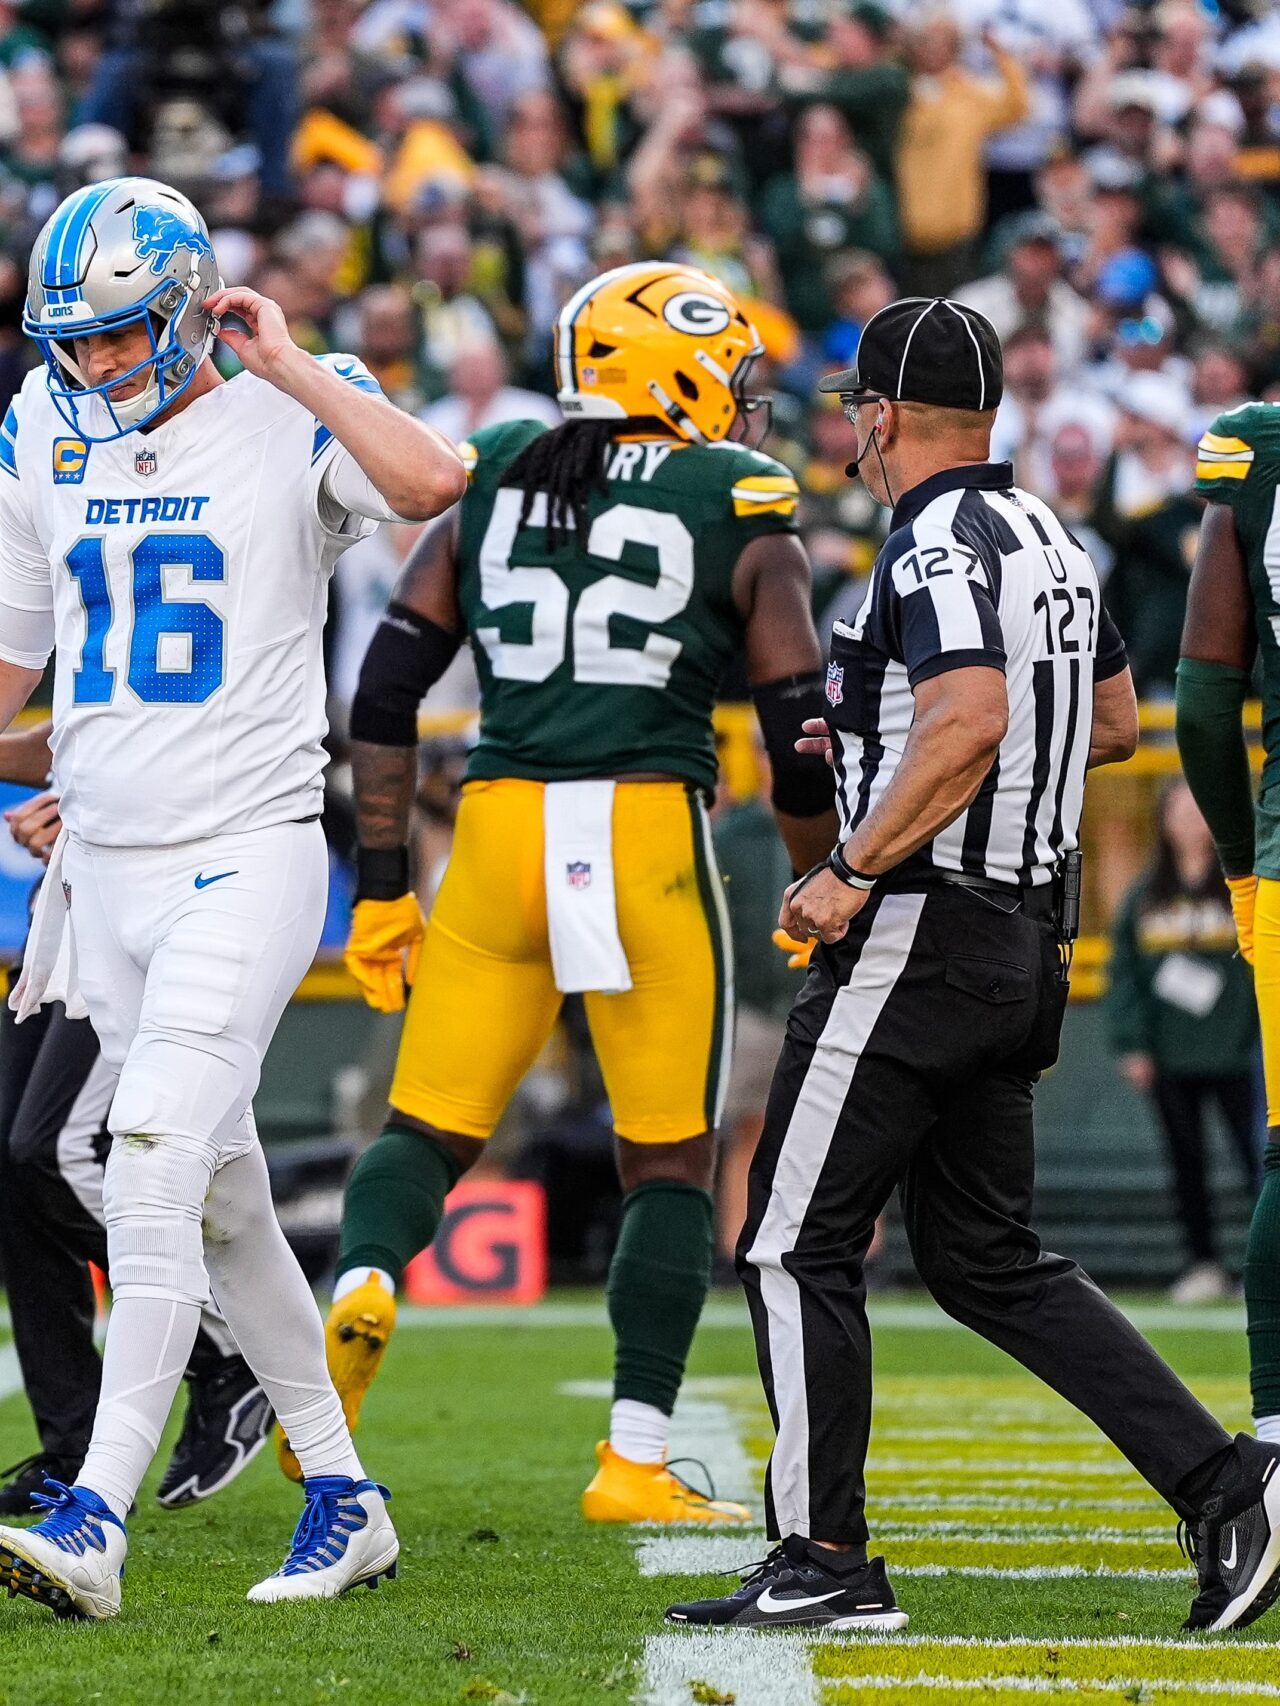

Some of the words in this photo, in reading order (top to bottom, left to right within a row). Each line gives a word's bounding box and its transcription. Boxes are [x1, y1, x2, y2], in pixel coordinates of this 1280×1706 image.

[48, 306, 73, 317] LIONS
[663, 291, 730, 336] G
[54, 440, 86, 472] C
[138, 461, 155, 474] NFL
[604, 443, 671, 482] RY
[85, 496, 210, 525] DETROIT
[902, 546, 979, 585] 127
[1043, 549, 1067, 584] U
[476, 487, 694, 688] 52
[63, 530, 228, 708] 16
[1033, 586, 1095, 656] 127
[827, 680, 841, 700] NFL
[432, 1201, 519, 1292] G
